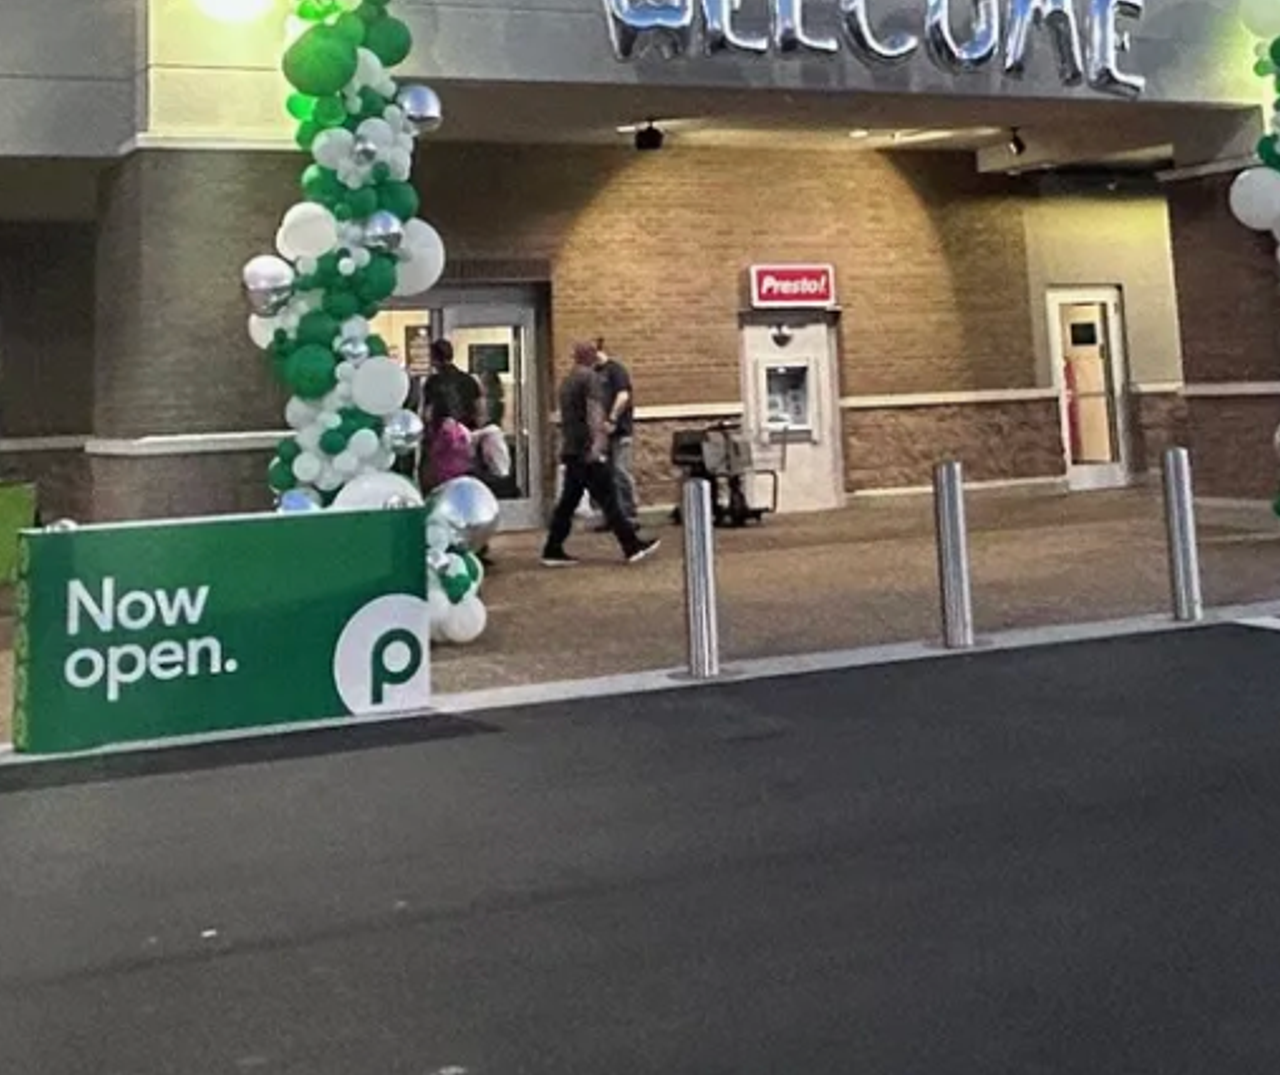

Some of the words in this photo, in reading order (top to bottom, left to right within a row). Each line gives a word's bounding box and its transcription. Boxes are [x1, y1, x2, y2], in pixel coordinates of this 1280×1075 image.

[760, 275, 827, 295] Presto!
[66, 576, 210, 635] Now
[64, 635, 239, 702] open.
